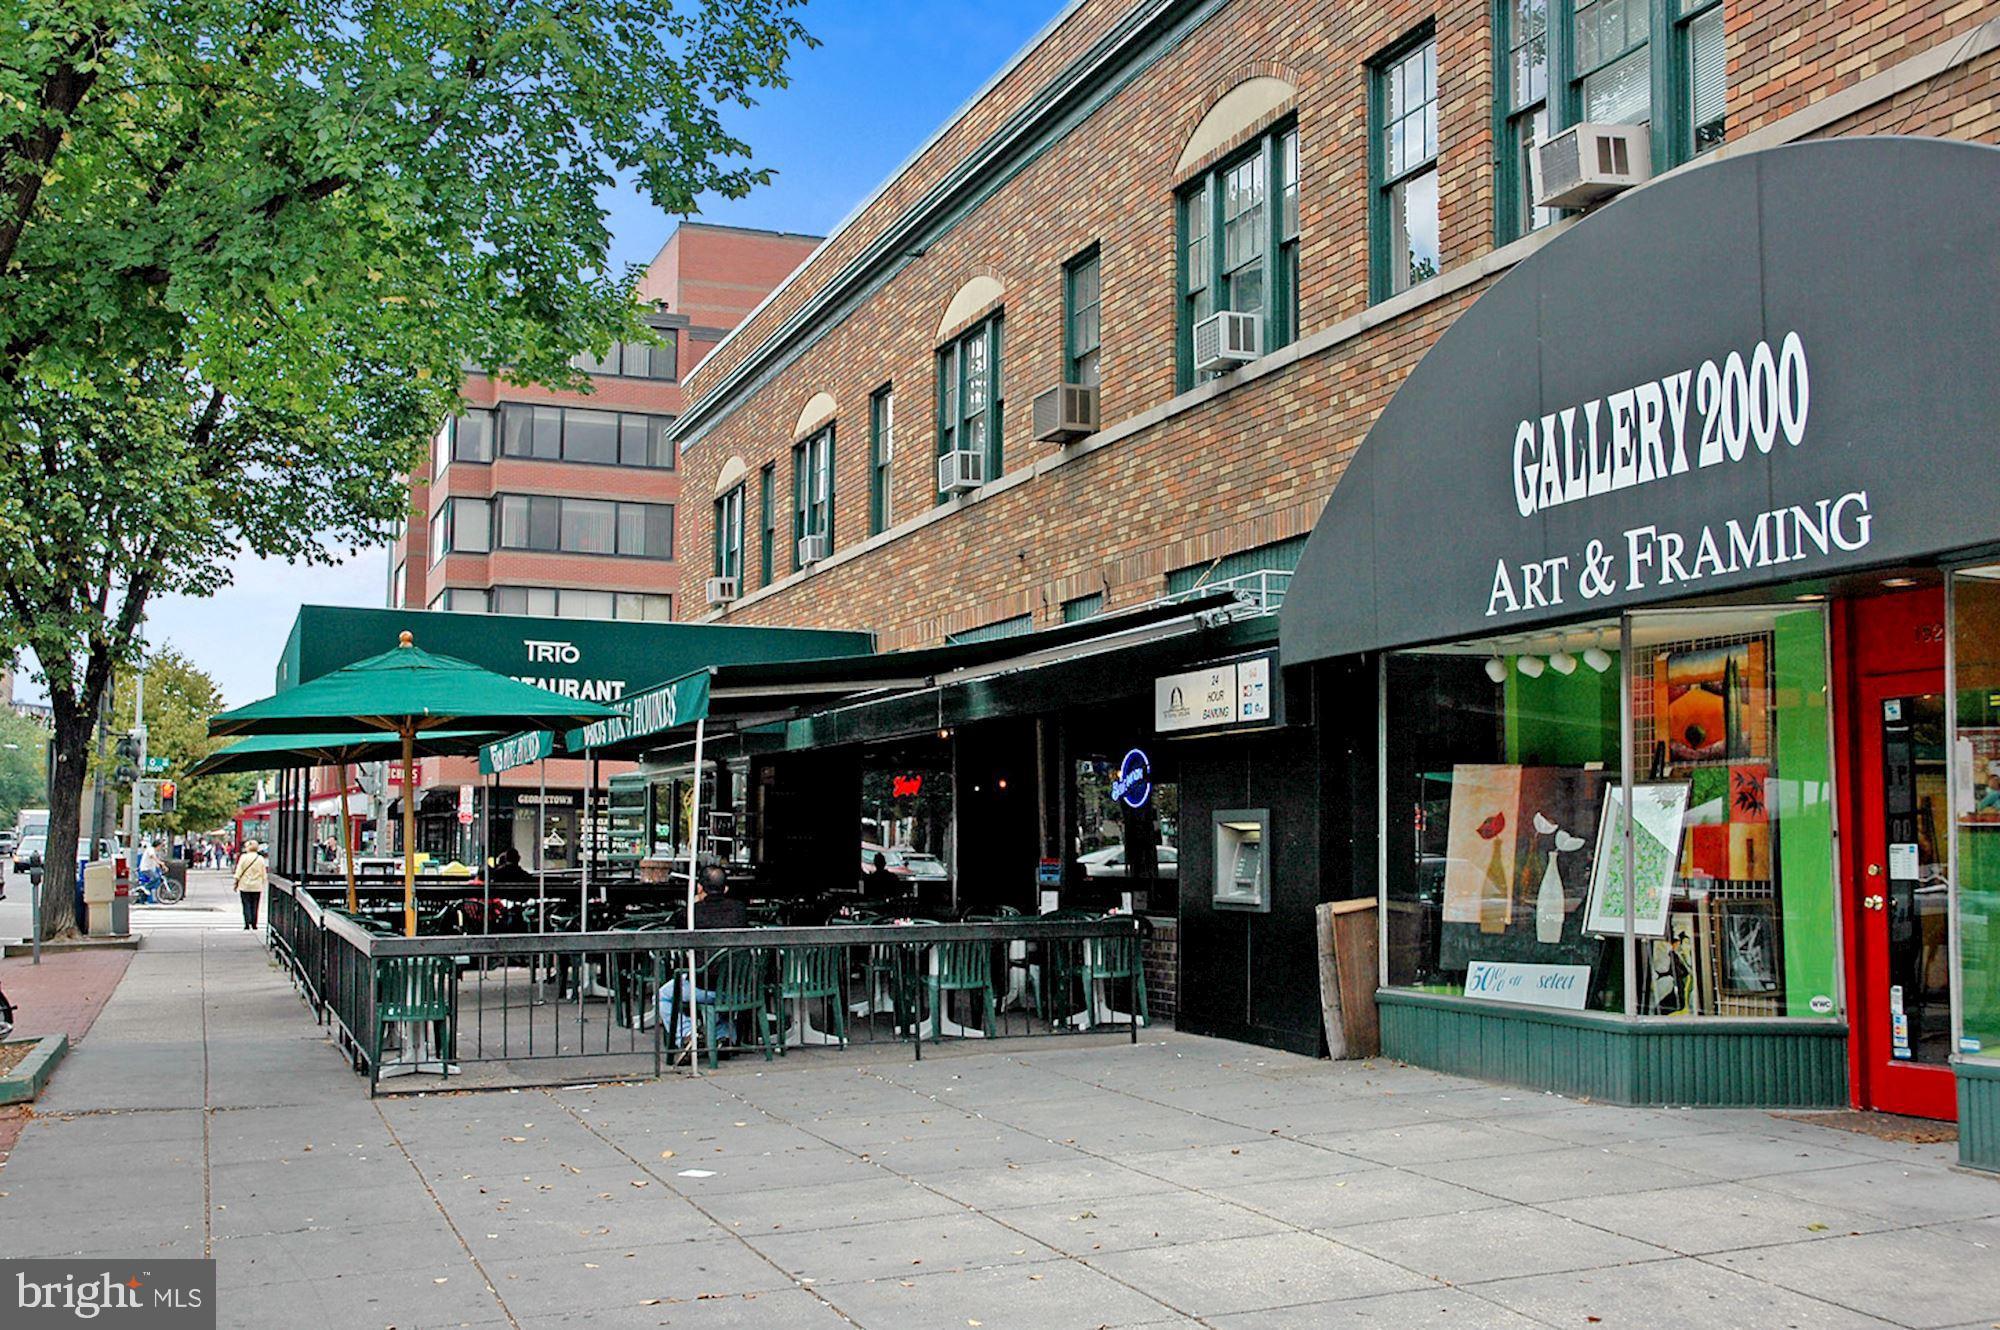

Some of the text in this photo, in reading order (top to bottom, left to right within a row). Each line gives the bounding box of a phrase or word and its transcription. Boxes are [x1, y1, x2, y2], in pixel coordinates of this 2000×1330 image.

[1513, 330, 1810, 517] GALLERY 2000
[1485, 490, 1873, 617] ART & FRAMING
[523, 640, 581, 664] TRIO
[1211, 675, 1220, 686] 24
[1206, 690, 1225, 703] HOUR
[633, 684, 677, 736] HOUNDS
[1202, 706, 1230, 720] BANKING
[517, 794, 574, 805] GEORETOWN
[1470, 966, 1506, 992] 50%
[1536, 972, 1575, 990] select
[1812, 1000, 1831, 1008] WWC
